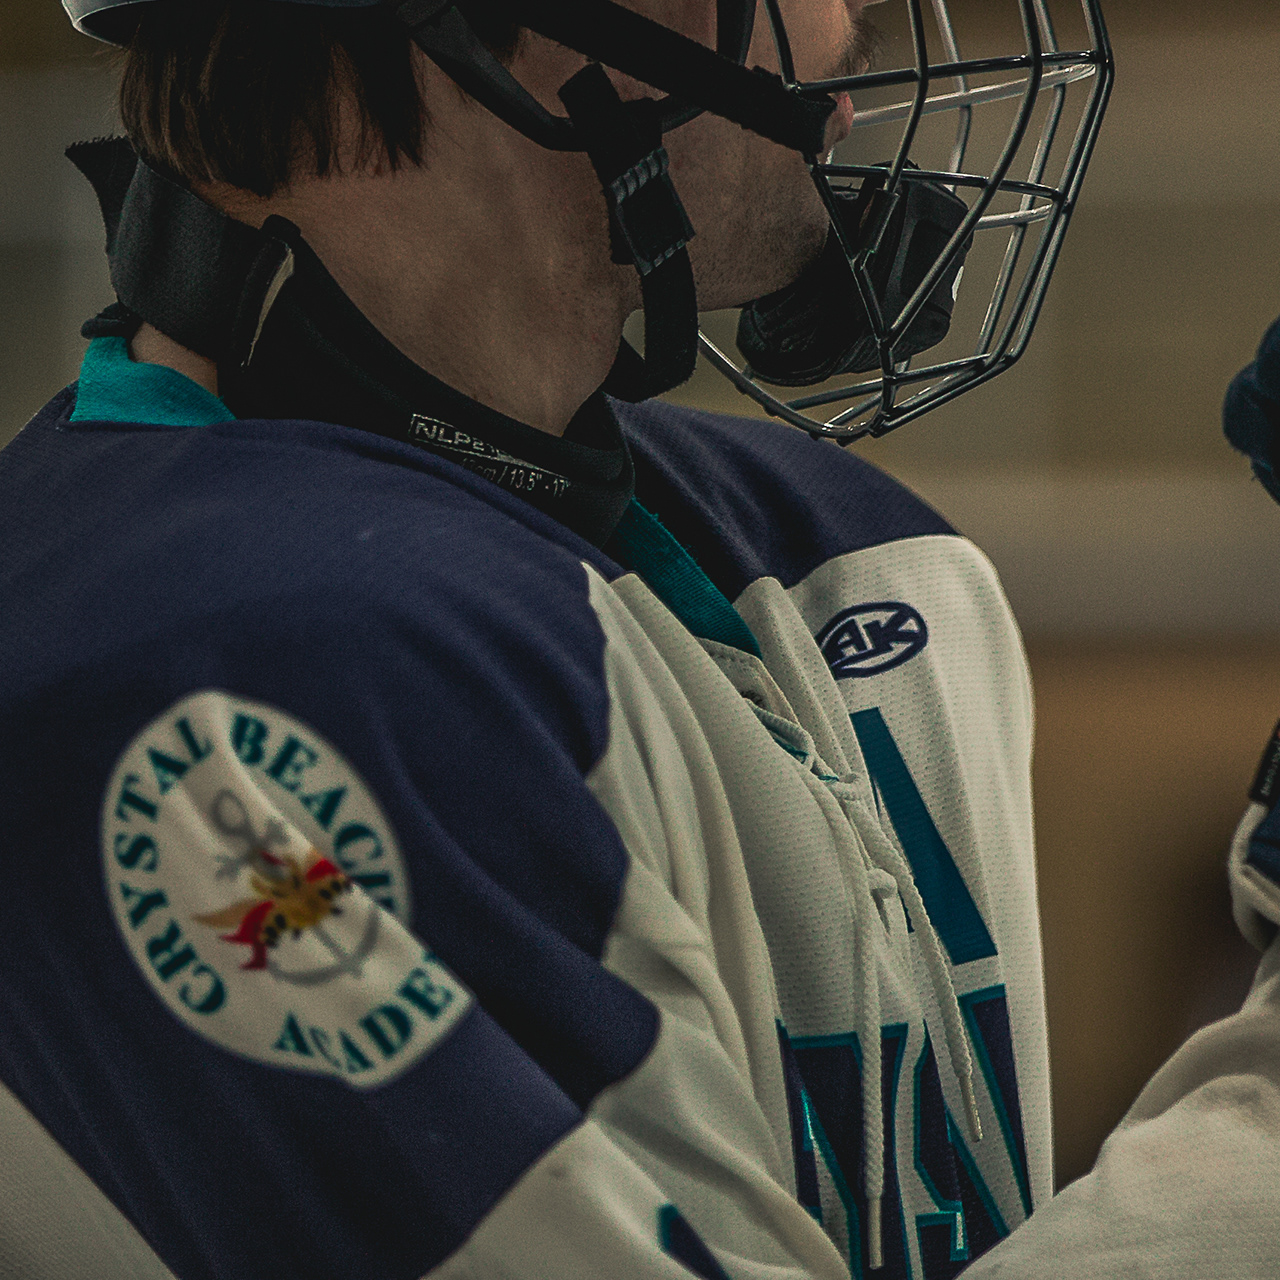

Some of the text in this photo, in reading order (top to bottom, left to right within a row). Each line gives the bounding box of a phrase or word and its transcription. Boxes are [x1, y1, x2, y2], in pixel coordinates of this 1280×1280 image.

[822, 608, 922, 665] AK
[113, 715, 229, 1016] CRYSTAL
[272, 950, 456, 1074] ACADE
